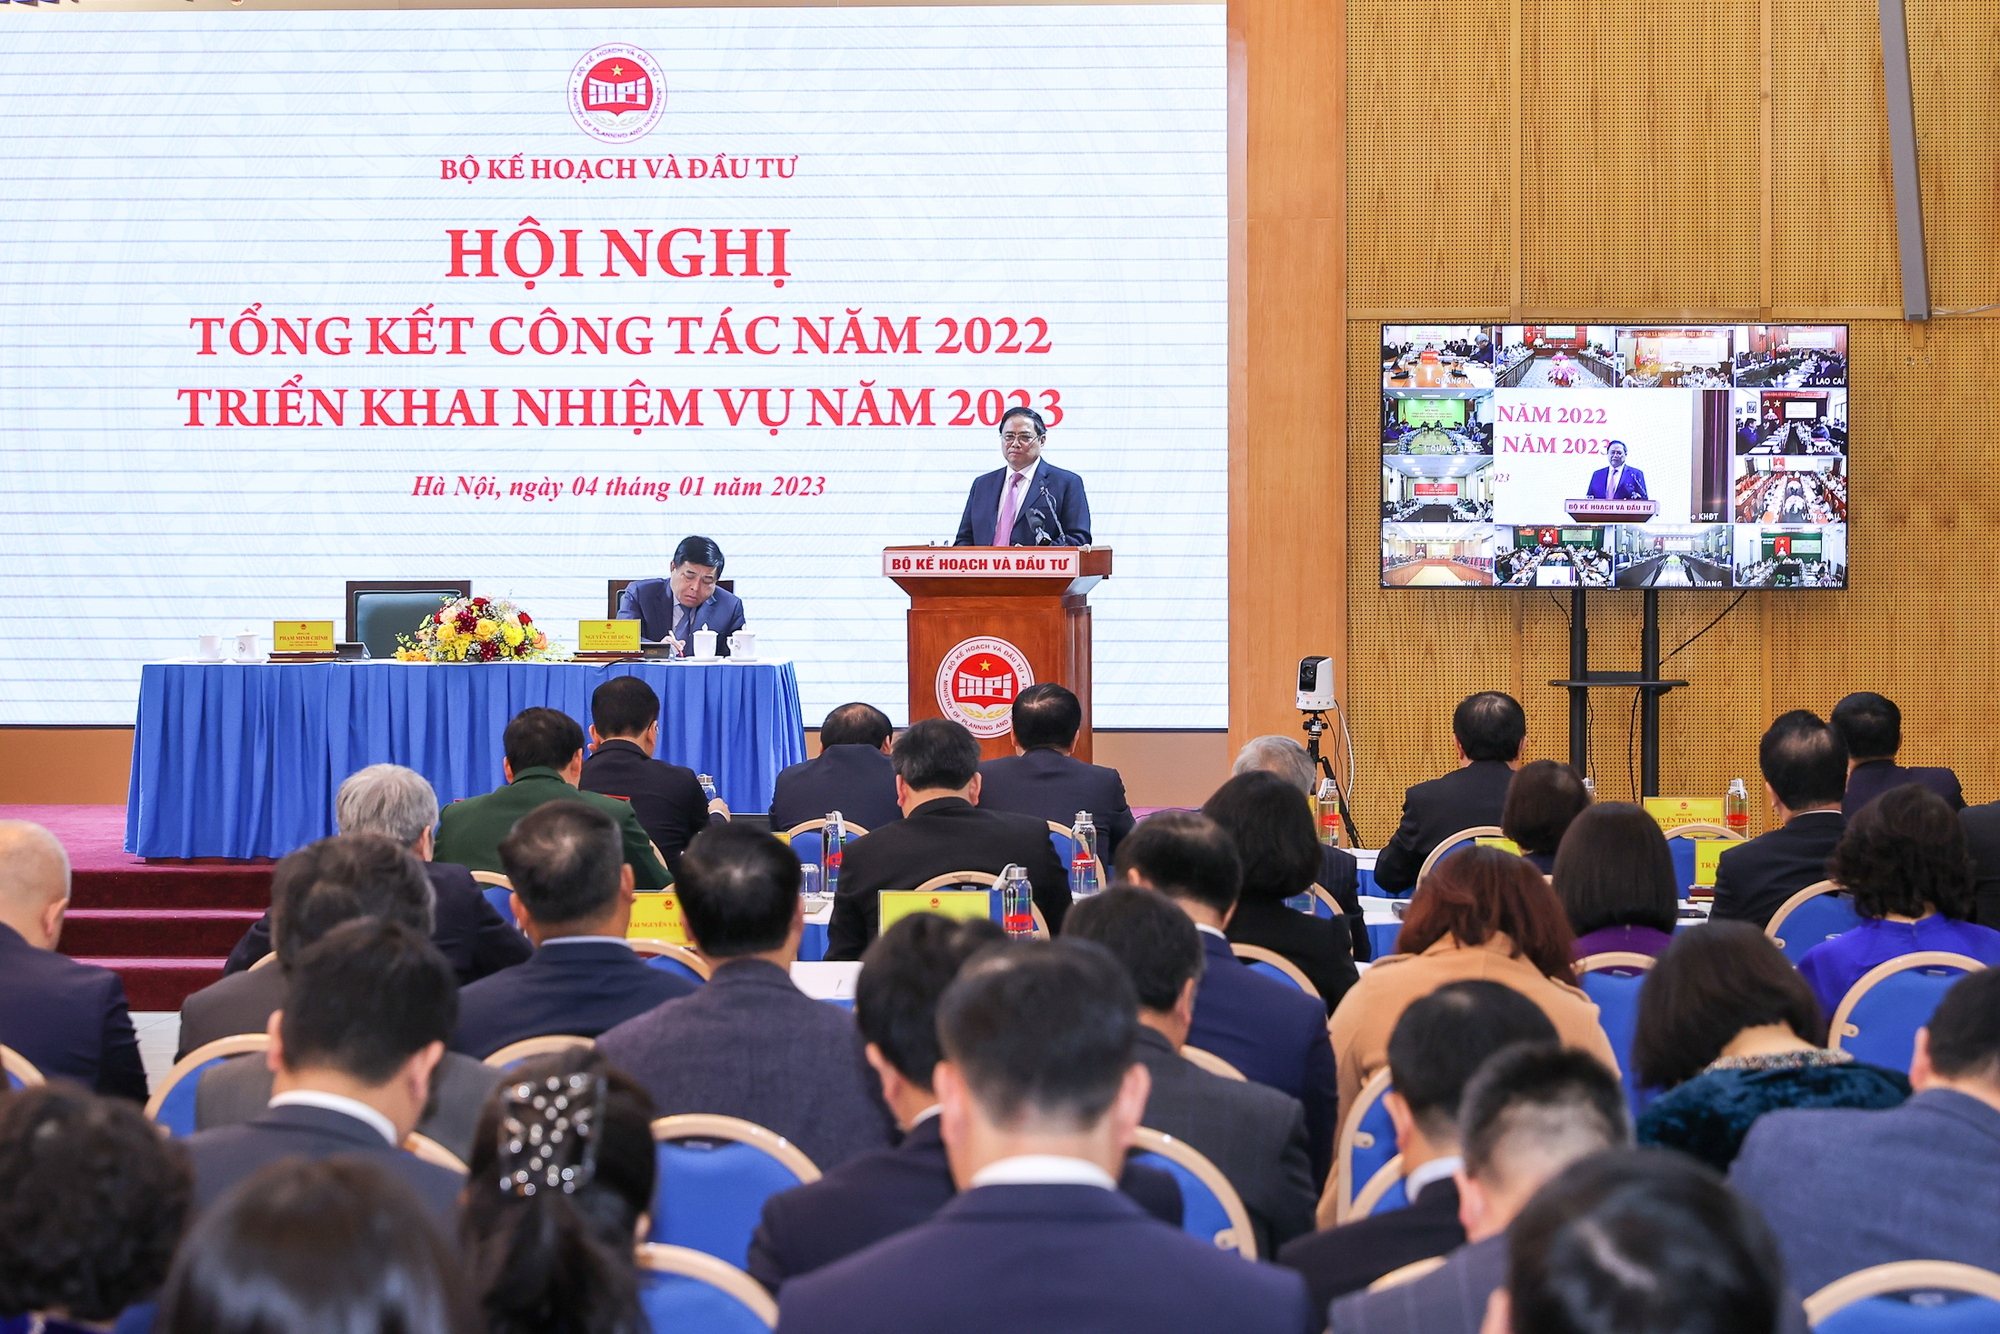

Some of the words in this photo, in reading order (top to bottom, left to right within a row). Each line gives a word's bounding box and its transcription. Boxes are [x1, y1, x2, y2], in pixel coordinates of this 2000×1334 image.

[440, 154, 480, 184] BỘ
[488, 152, 525, 179] KẾ
[531, 158, 637, 183] HOẠCH
[644, 153, 683, 179] VÀ
[688, 152, 750, 179] ĐẦU
[756, 154, 799, 179] TƯ
[445, 215, 585, 290] HỘI
[600, 227, 792, 289] NGHỊ
[190, 302, 353, 355] TỔNG
[365, 303, 474, 355] KẾT
[489, 306, 654, 355] CÔNG
[668, 306, 781, 355] TÁC
[793, 307, 922, 354] NĂM
[935, 316, 1053, 354] 2022
[1816, 377, 1831, 385] LAO
[1832, 377, 1845, 385] CAI
[177, 373, 349, 427] TRIỂN
[359, 388, 499, 427] KHAI
[512, 378, 704, 436] NHIỆM
[713, 388, 795, 436] VỤ
[806, 379, 936, 427] NĂM
[1497, 402, 1551, 423] NĂM
[1557, 407, 1607, 424] 2022
[1502, 432, 1557, 453] NĂM
[1562, 437, 1611, 455] 2023
[411, 476, 446, 497] Hà
[454, 476, 501, 501] Nội,
[509, 476, 564, 503] ngày
[571, 476, 599, 497] 04
[605, 475, 671, 503] tháng
[679, 476, 705, 497] 01
[713, 477, 763, 497] năm
[771, 475, 826, 497] 2023
[892, 557, 911, 573] BỘ
[916, 554, 935, 570] KẾ
[939, 558, 988, 573] HOẠCH
[993, 556, 1011, 570] VÀ
[1015, 554, 1046, 571] ĐẦU
[1050, 557, 1070, 571] TƯ
[947, 660, 956, 671] BỘ
[955, 650, 965, 660] KẾ
[965, 644, 990, 653] HOẠCH
[992, 644, 1002, 652] VÀ
[1003, 650, 1017, 663] ĐẦU
[1016, 663, 1024, 673] TƯ
[943, 679, 953, 710] MINISTRY
[952, 710, 961, 719] OF
[961, 718, 994, 731] PLANNING
[995, 719, 1009, 729] AND
